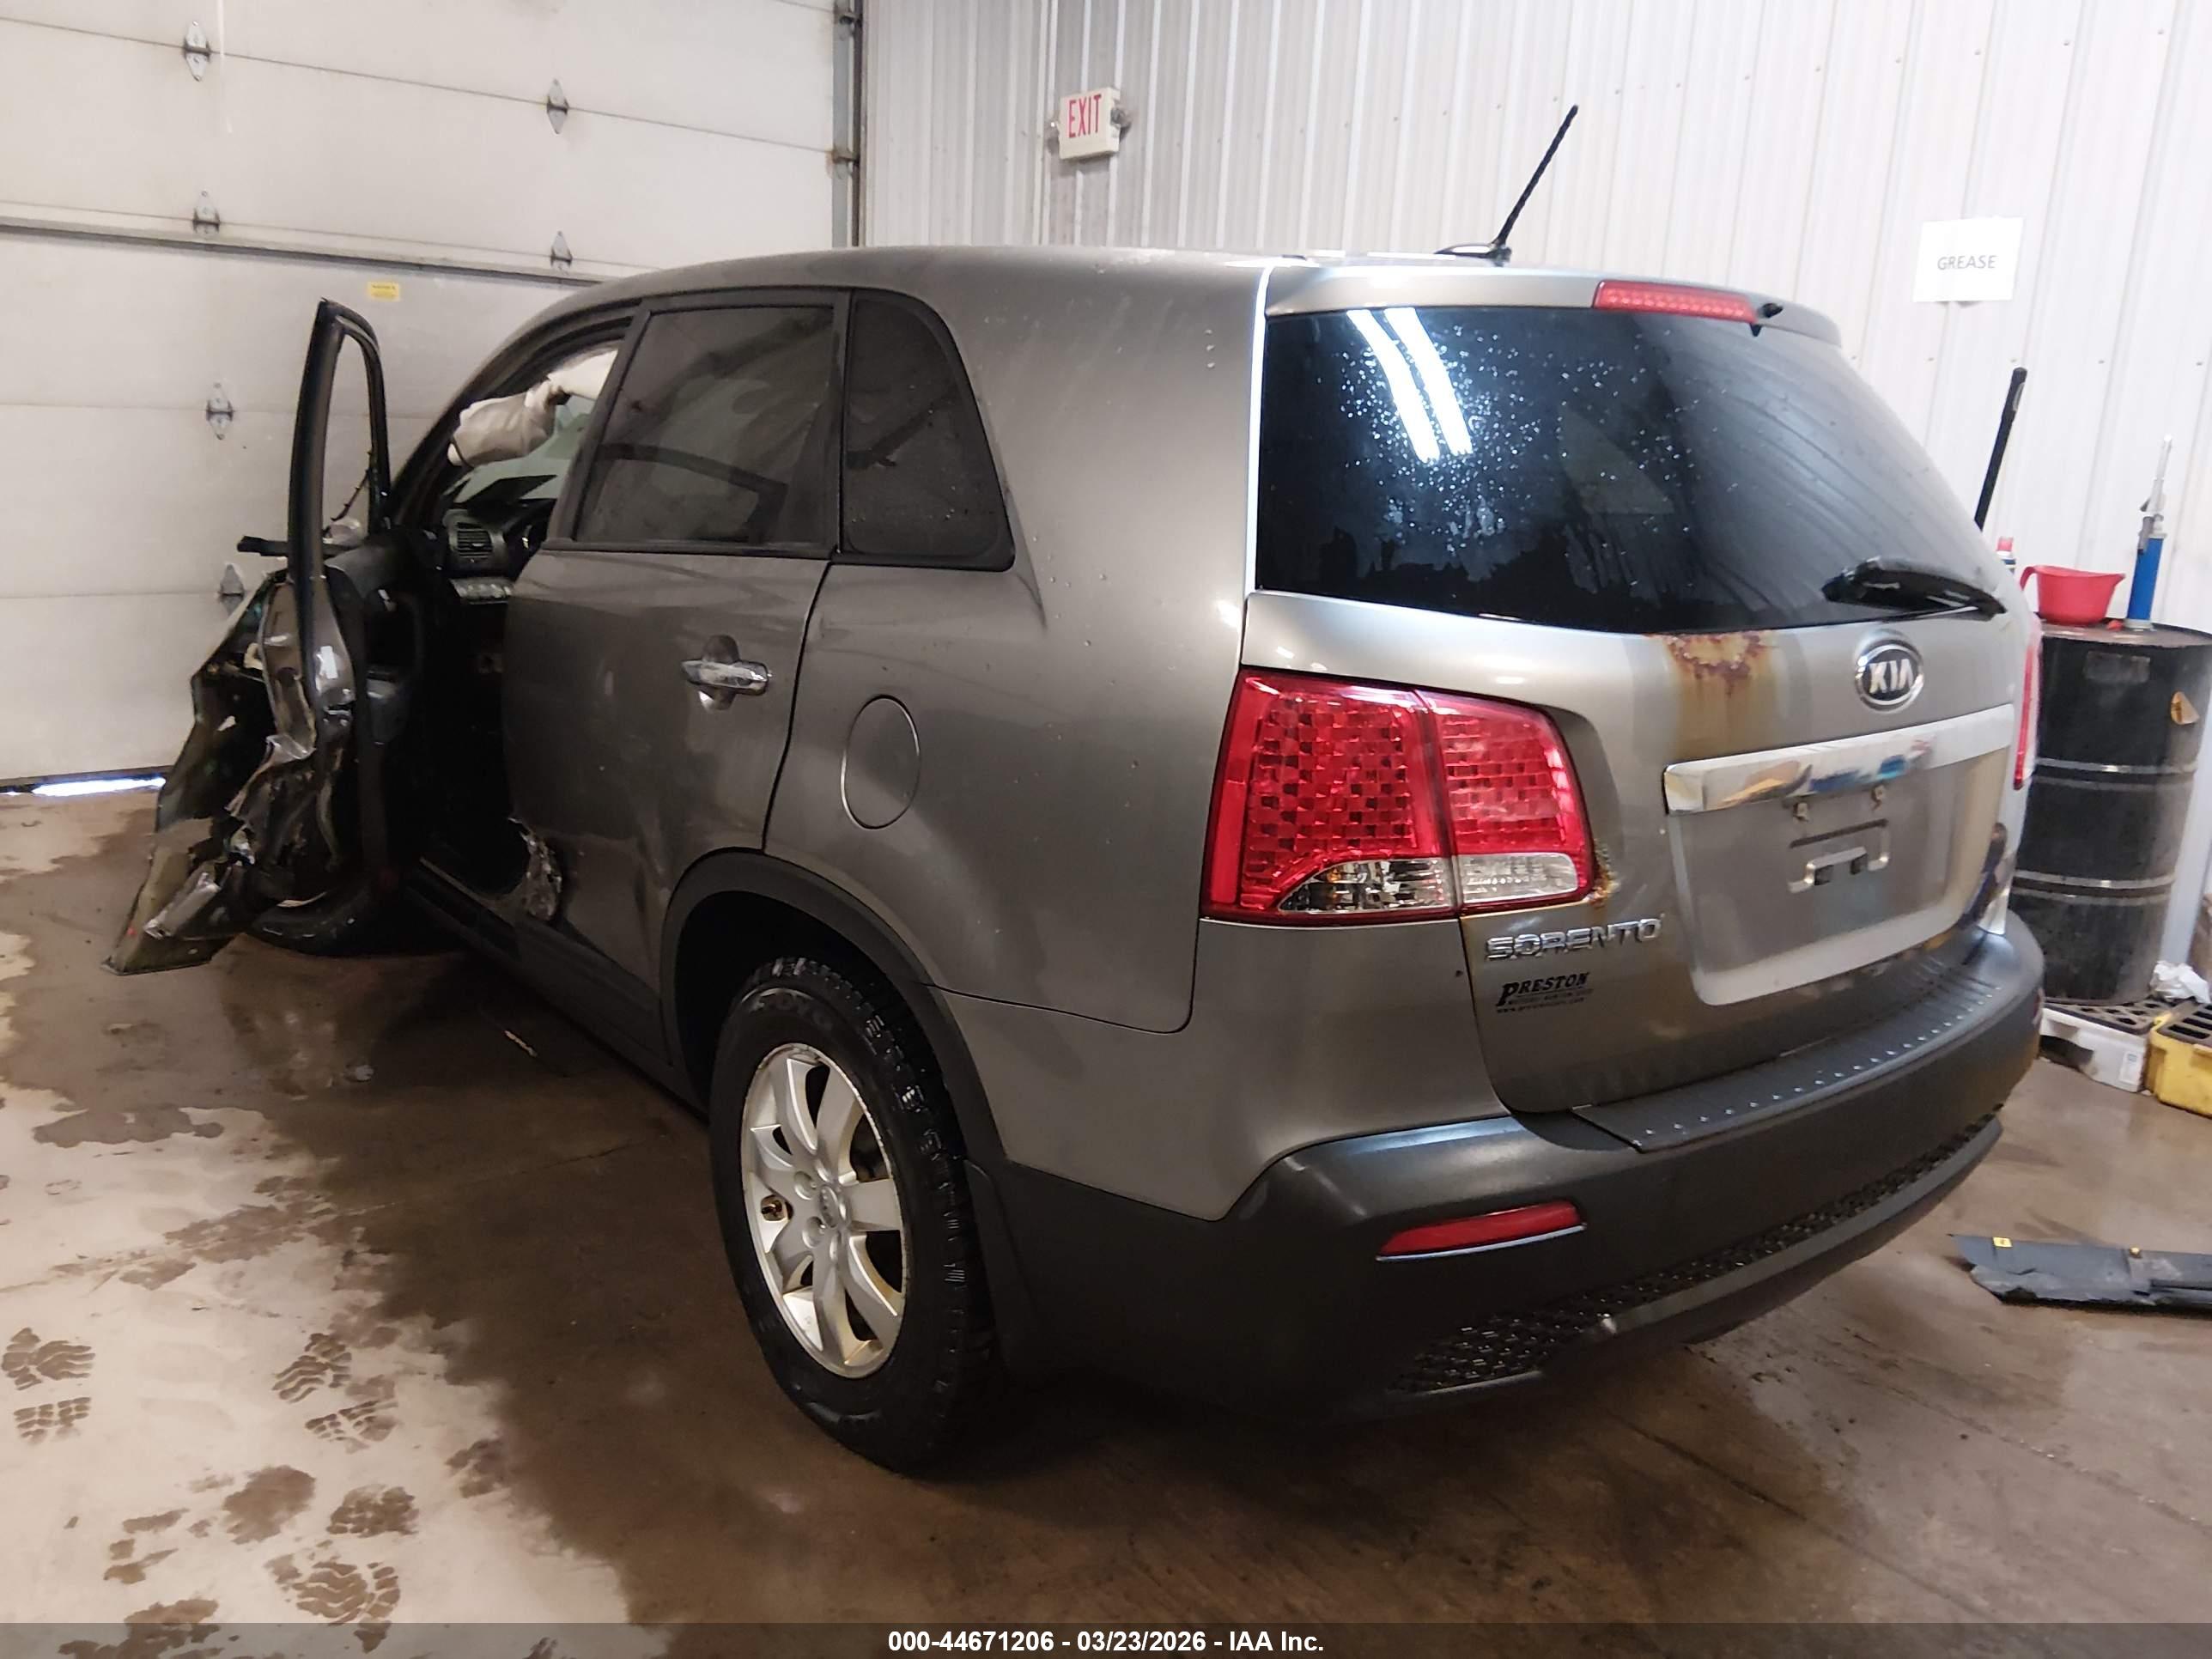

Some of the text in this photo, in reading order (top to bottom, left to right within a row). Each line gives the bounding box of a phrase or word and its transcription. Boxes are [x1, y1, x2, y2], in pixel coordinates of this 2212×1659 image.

[1068, 94, 1102, 138] EXIT
[1937, 255, 1996, 270] GREASE
[1486, 918, 1662, 959] SORENTO
[1496, 972, 1589, 1006] PRESTON
